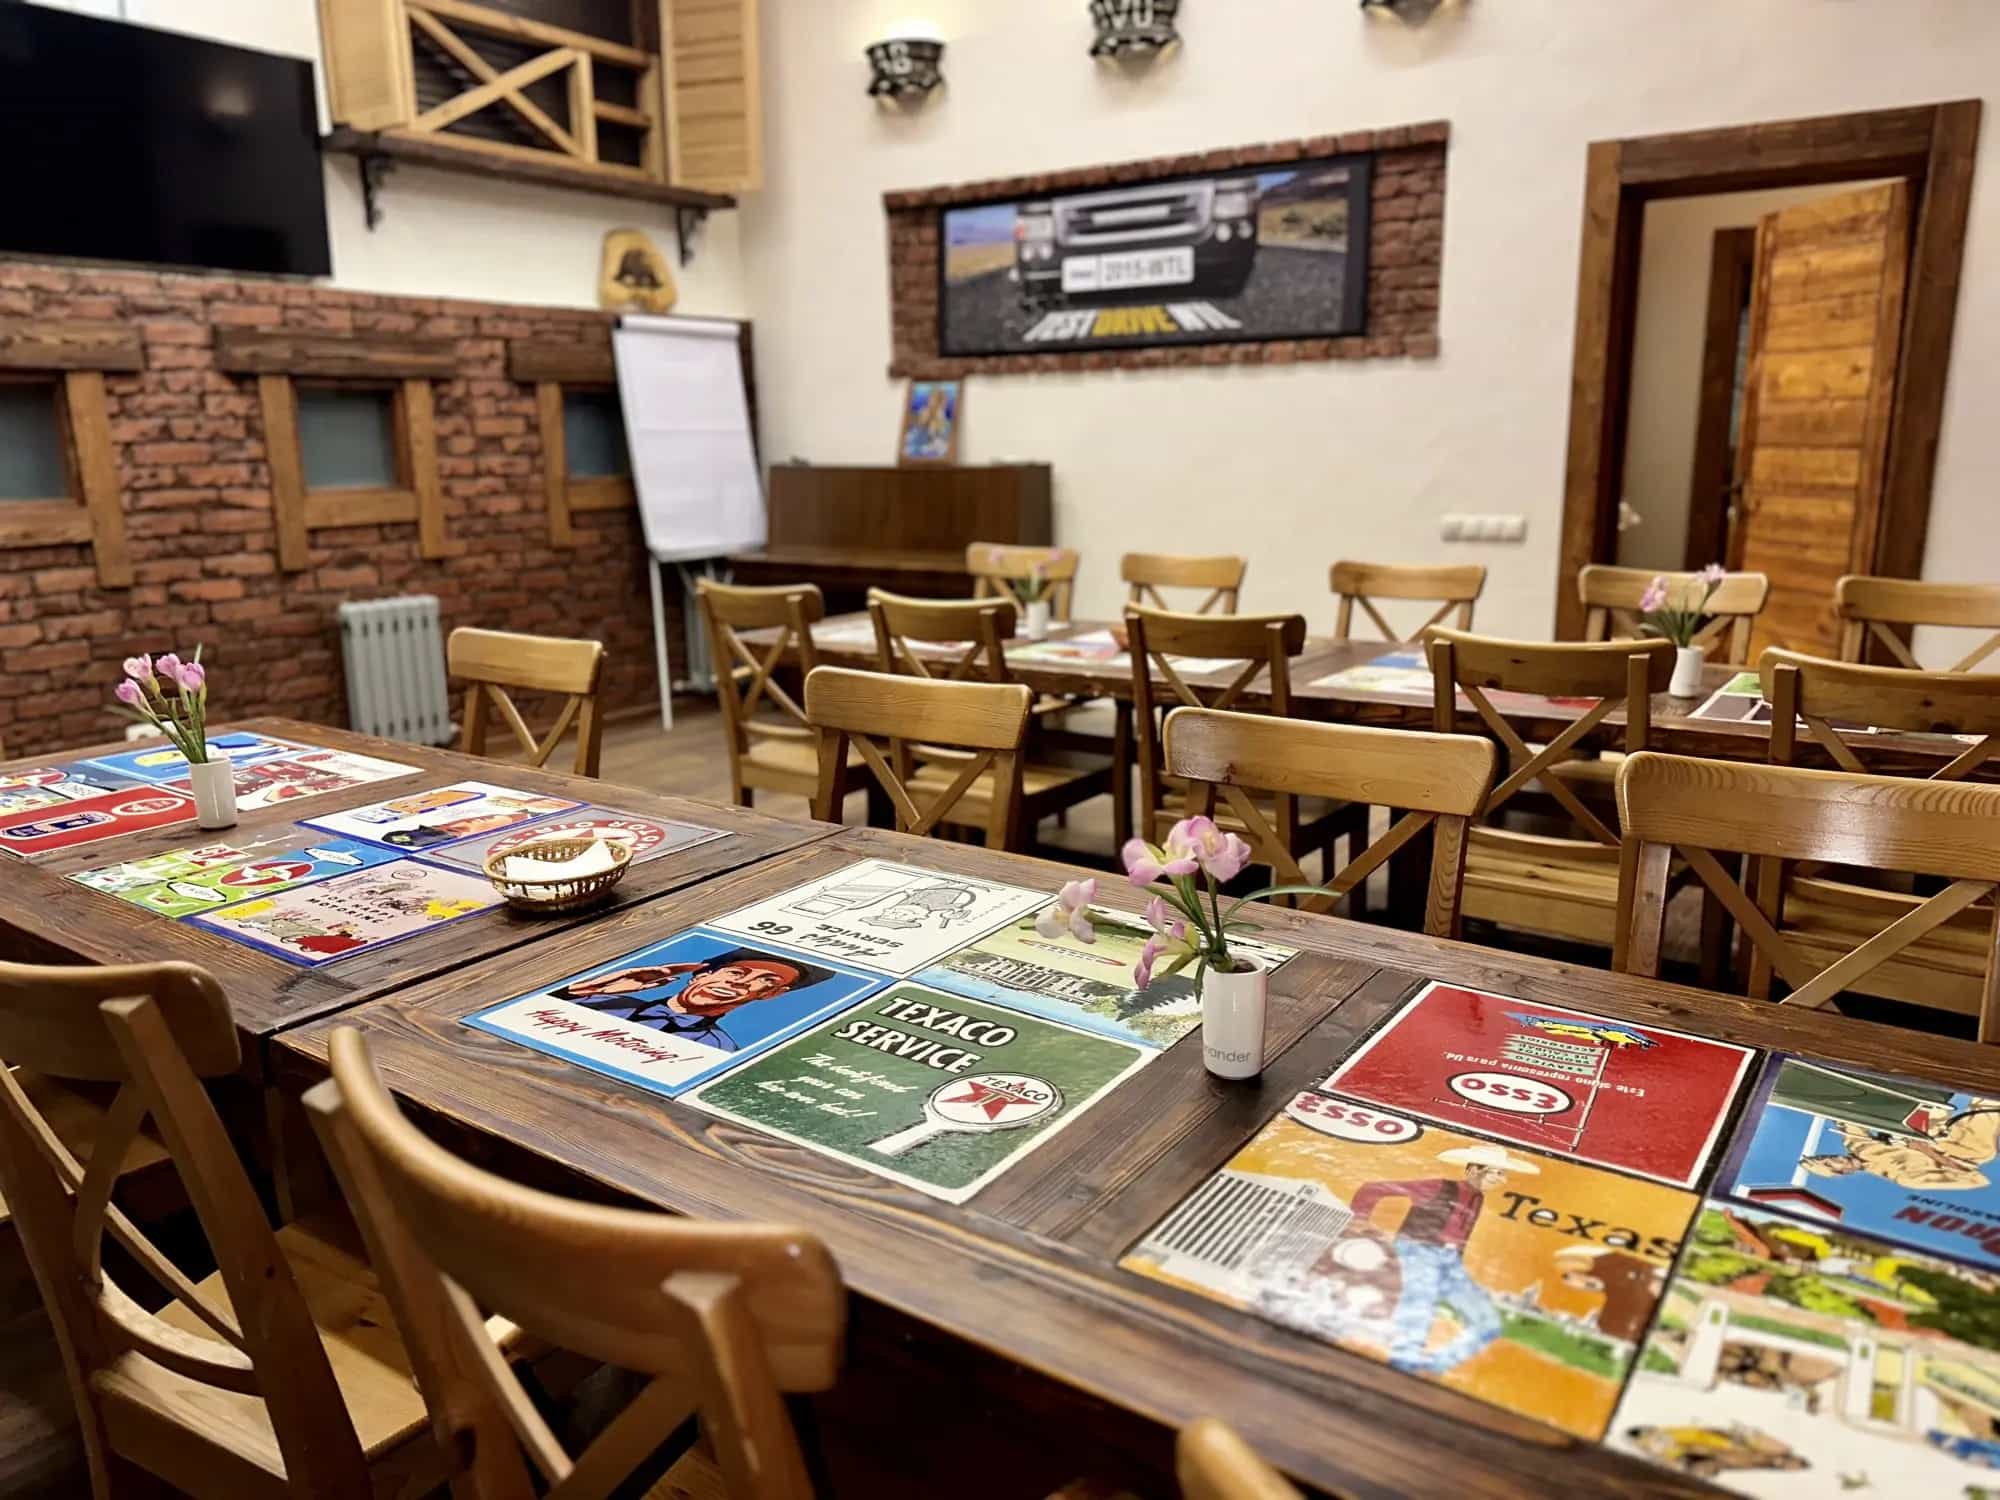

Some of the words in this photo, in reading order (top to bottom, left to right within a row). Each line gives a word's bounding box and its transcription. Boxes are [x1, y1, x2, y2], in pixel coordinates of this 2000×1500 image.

[747, 921, 793, 935] 66
[816, 924, 905, 948] SERVICE
[881, 996, 1017, 1048] TEXACO
[524, 1009, 593, 1035] Happy
[581, 1028, 704, 1064] Motoring!
[834, 1020, 983, 1074] SERVICE
[1206, 1047, 1252, 1064] ander
[1466, 1055, 1499, 1067] para
[982, 1076, 1049, 1101] TEXACO
[1497, 1190, 1679, 1260] Texas
